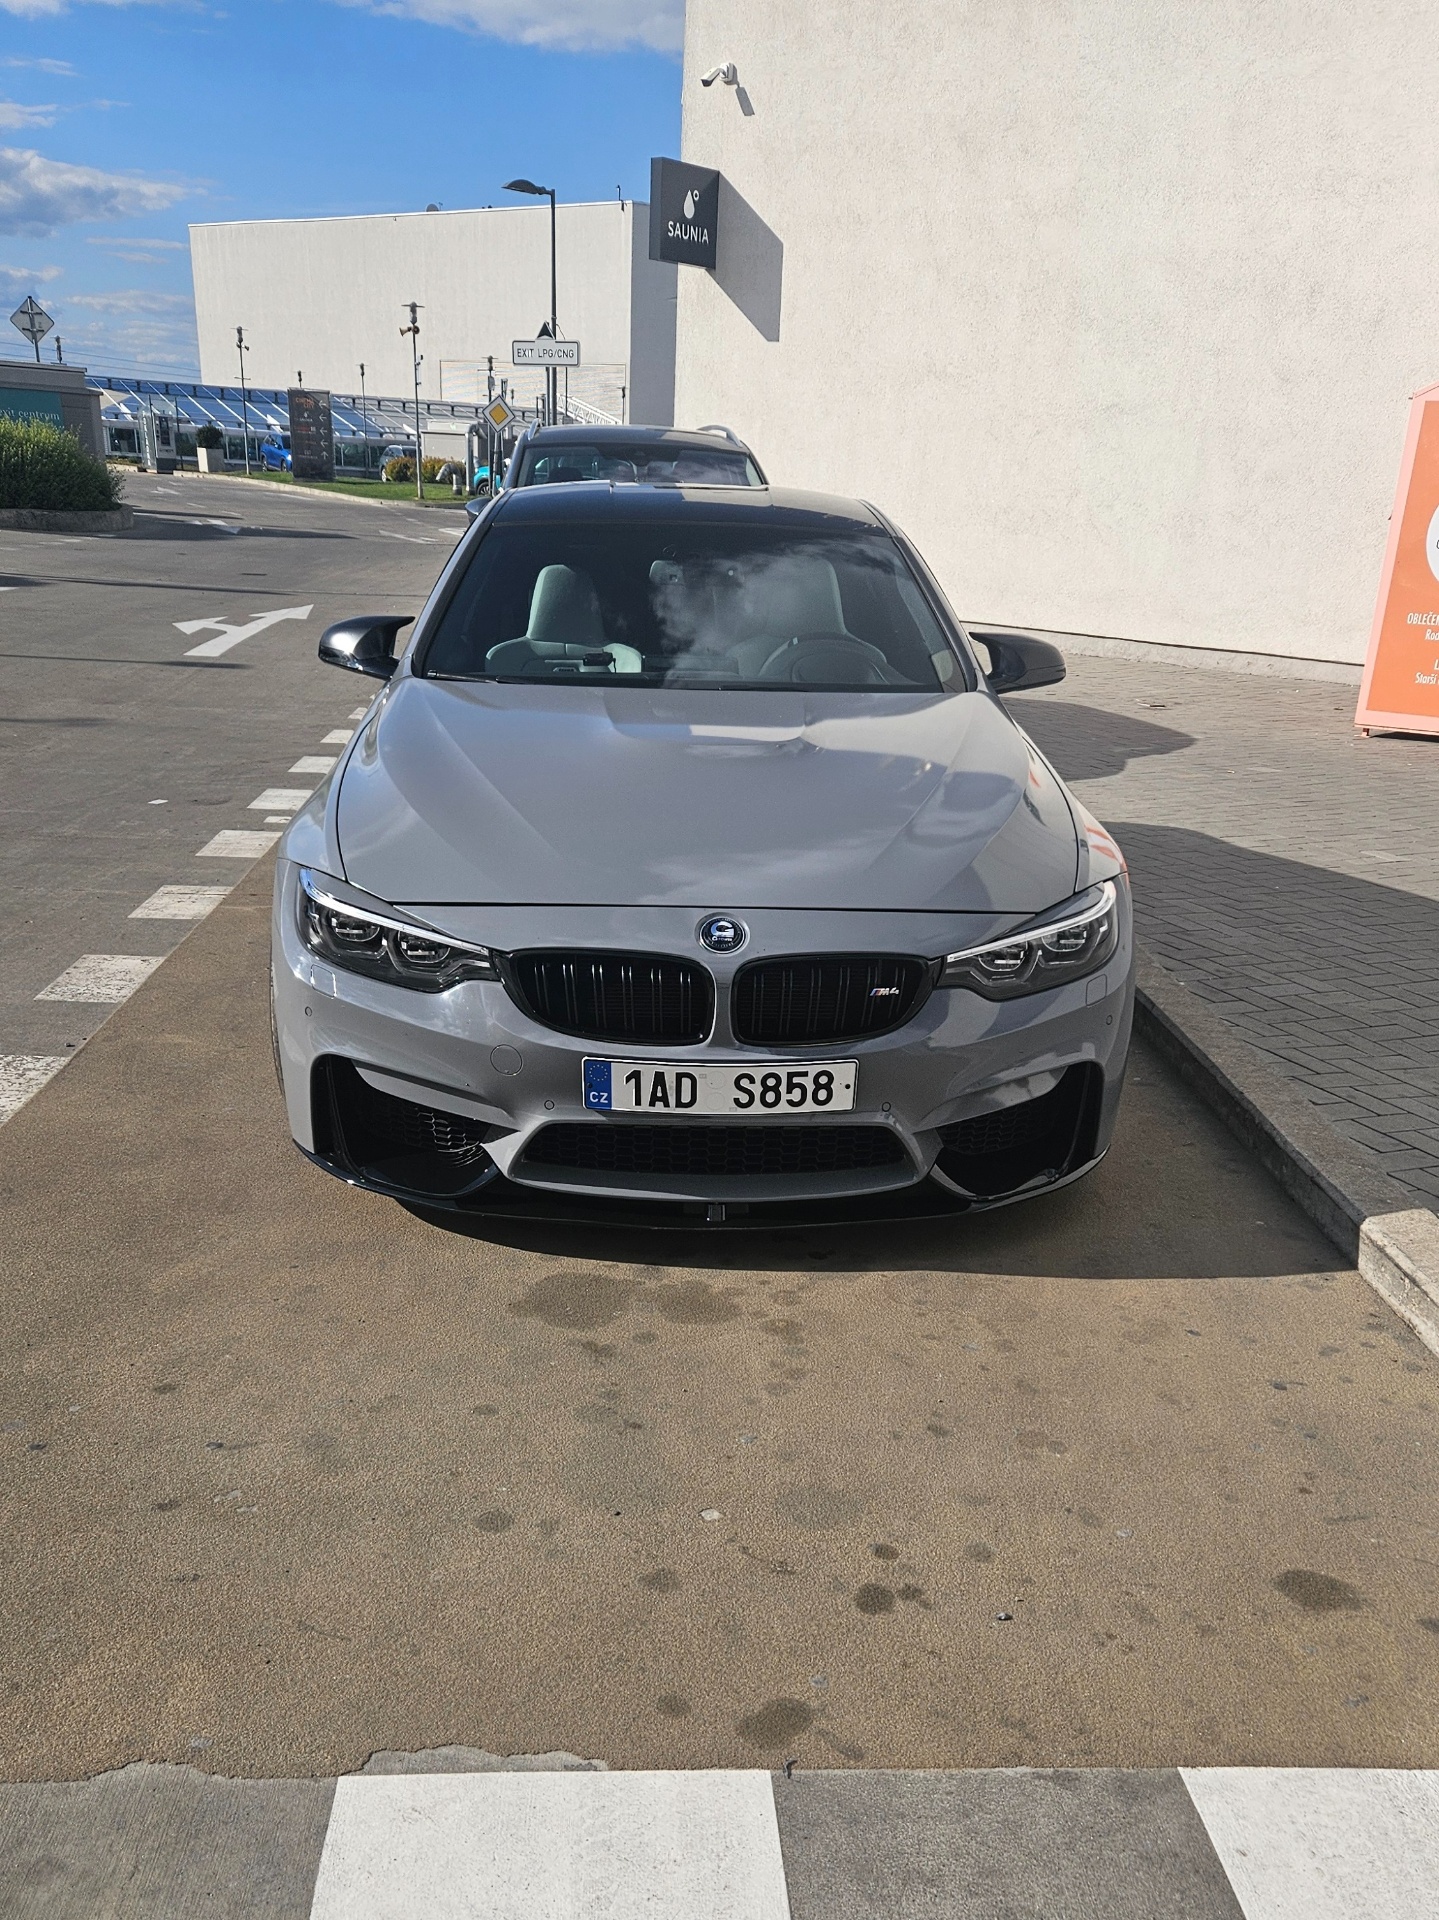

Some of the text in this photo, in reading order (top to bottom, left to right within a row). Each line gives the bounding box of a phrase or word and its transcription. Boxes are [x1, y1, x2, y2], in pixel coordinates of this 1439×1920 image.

[667, 221, 709, 244] SAUNIA
[517, 348, 574, 358] EXIT LPG/CNG
[18, 410, 60, 420] centrum
[1415, 672, 1438, 685] Starší
[624, 1069, 835, 1109] 1AD S858
[589, 1091, 609, 1104] CZ
